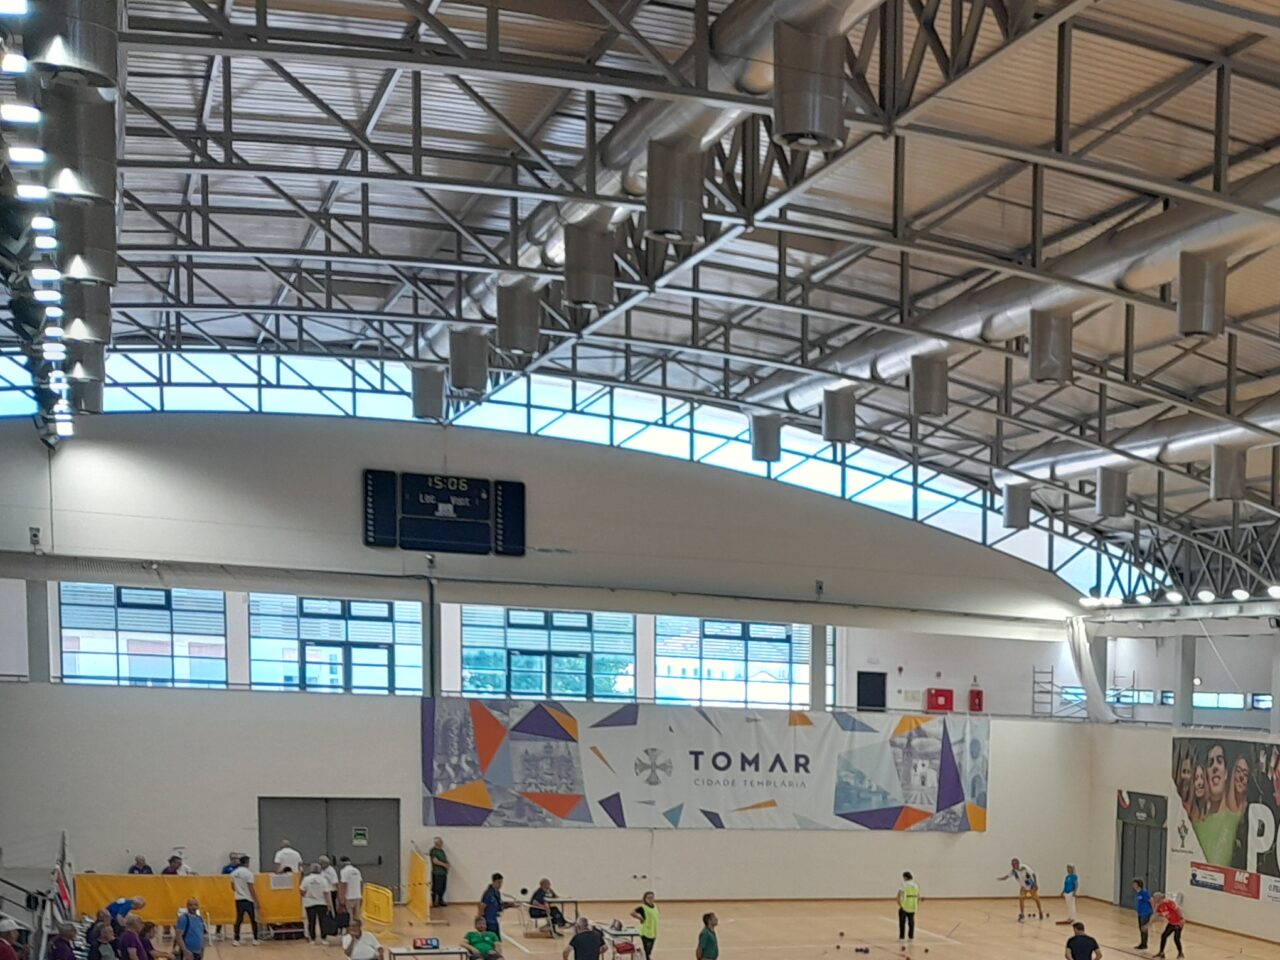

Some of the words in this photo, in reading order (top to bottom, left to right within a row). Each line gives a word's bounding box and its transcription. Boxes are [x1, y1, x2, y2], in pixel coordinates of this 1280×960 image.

[428, 476, 468, 491] 15:06
[689, 750, 811, 774] TOMAR
[694, 778, 736, 788] CIDADE
